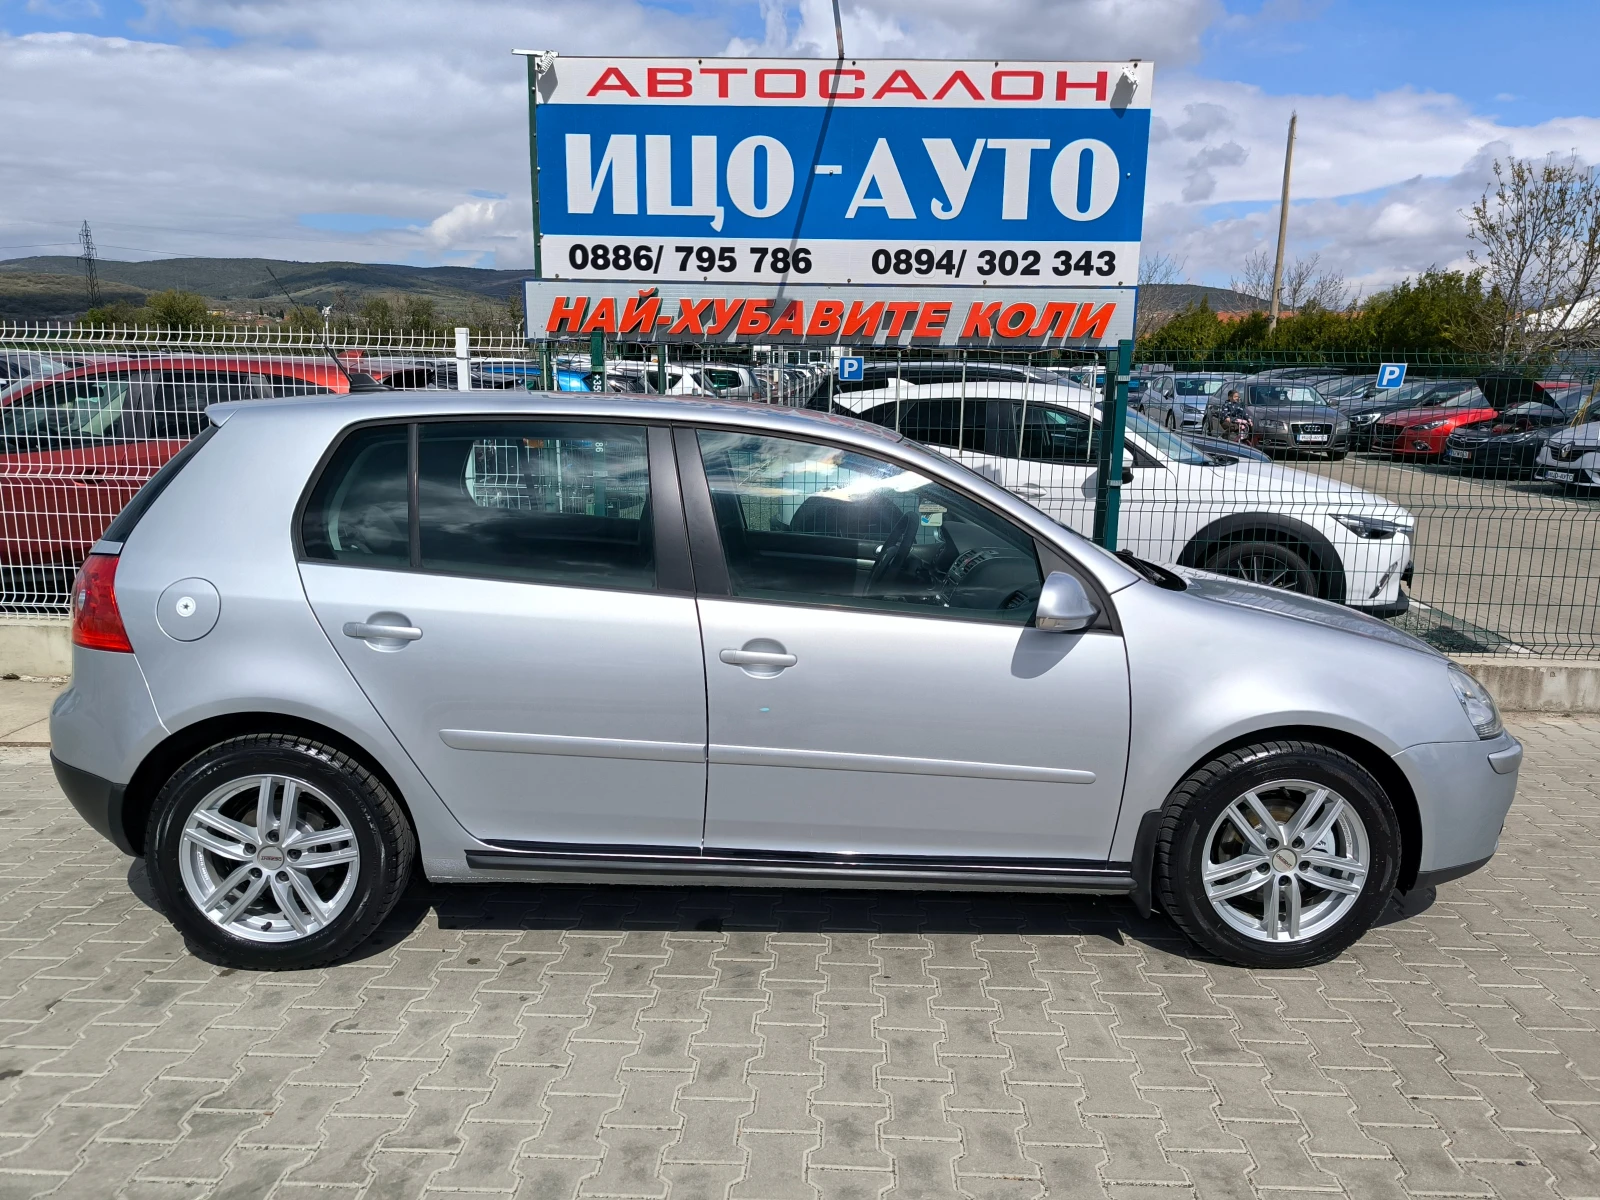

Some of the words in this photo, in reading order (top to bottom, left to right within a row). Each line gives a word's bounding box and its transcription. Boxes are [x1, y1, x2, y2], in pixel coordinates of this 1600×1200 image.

[586, 66, 1109, 102] АВТОСАЛОН
[568, 243, 664, 275] 0886/
[674, 244, 737, 273] 795
[749, 247, 813, 275] 786
[871, 247, 968, 279] 0894/
[976, 249, 1041, 277] 302
[1051, 250, 1116, 277] 343
[545, 286, 954, 338] НАЙ-ХУБАВИТЕ
[961, 301, 1117, 339] КОЛИ
[593, 374, 602, 392] +35
[843, 359, 859, 378] P
[1381, 366, 1400, 386] P
